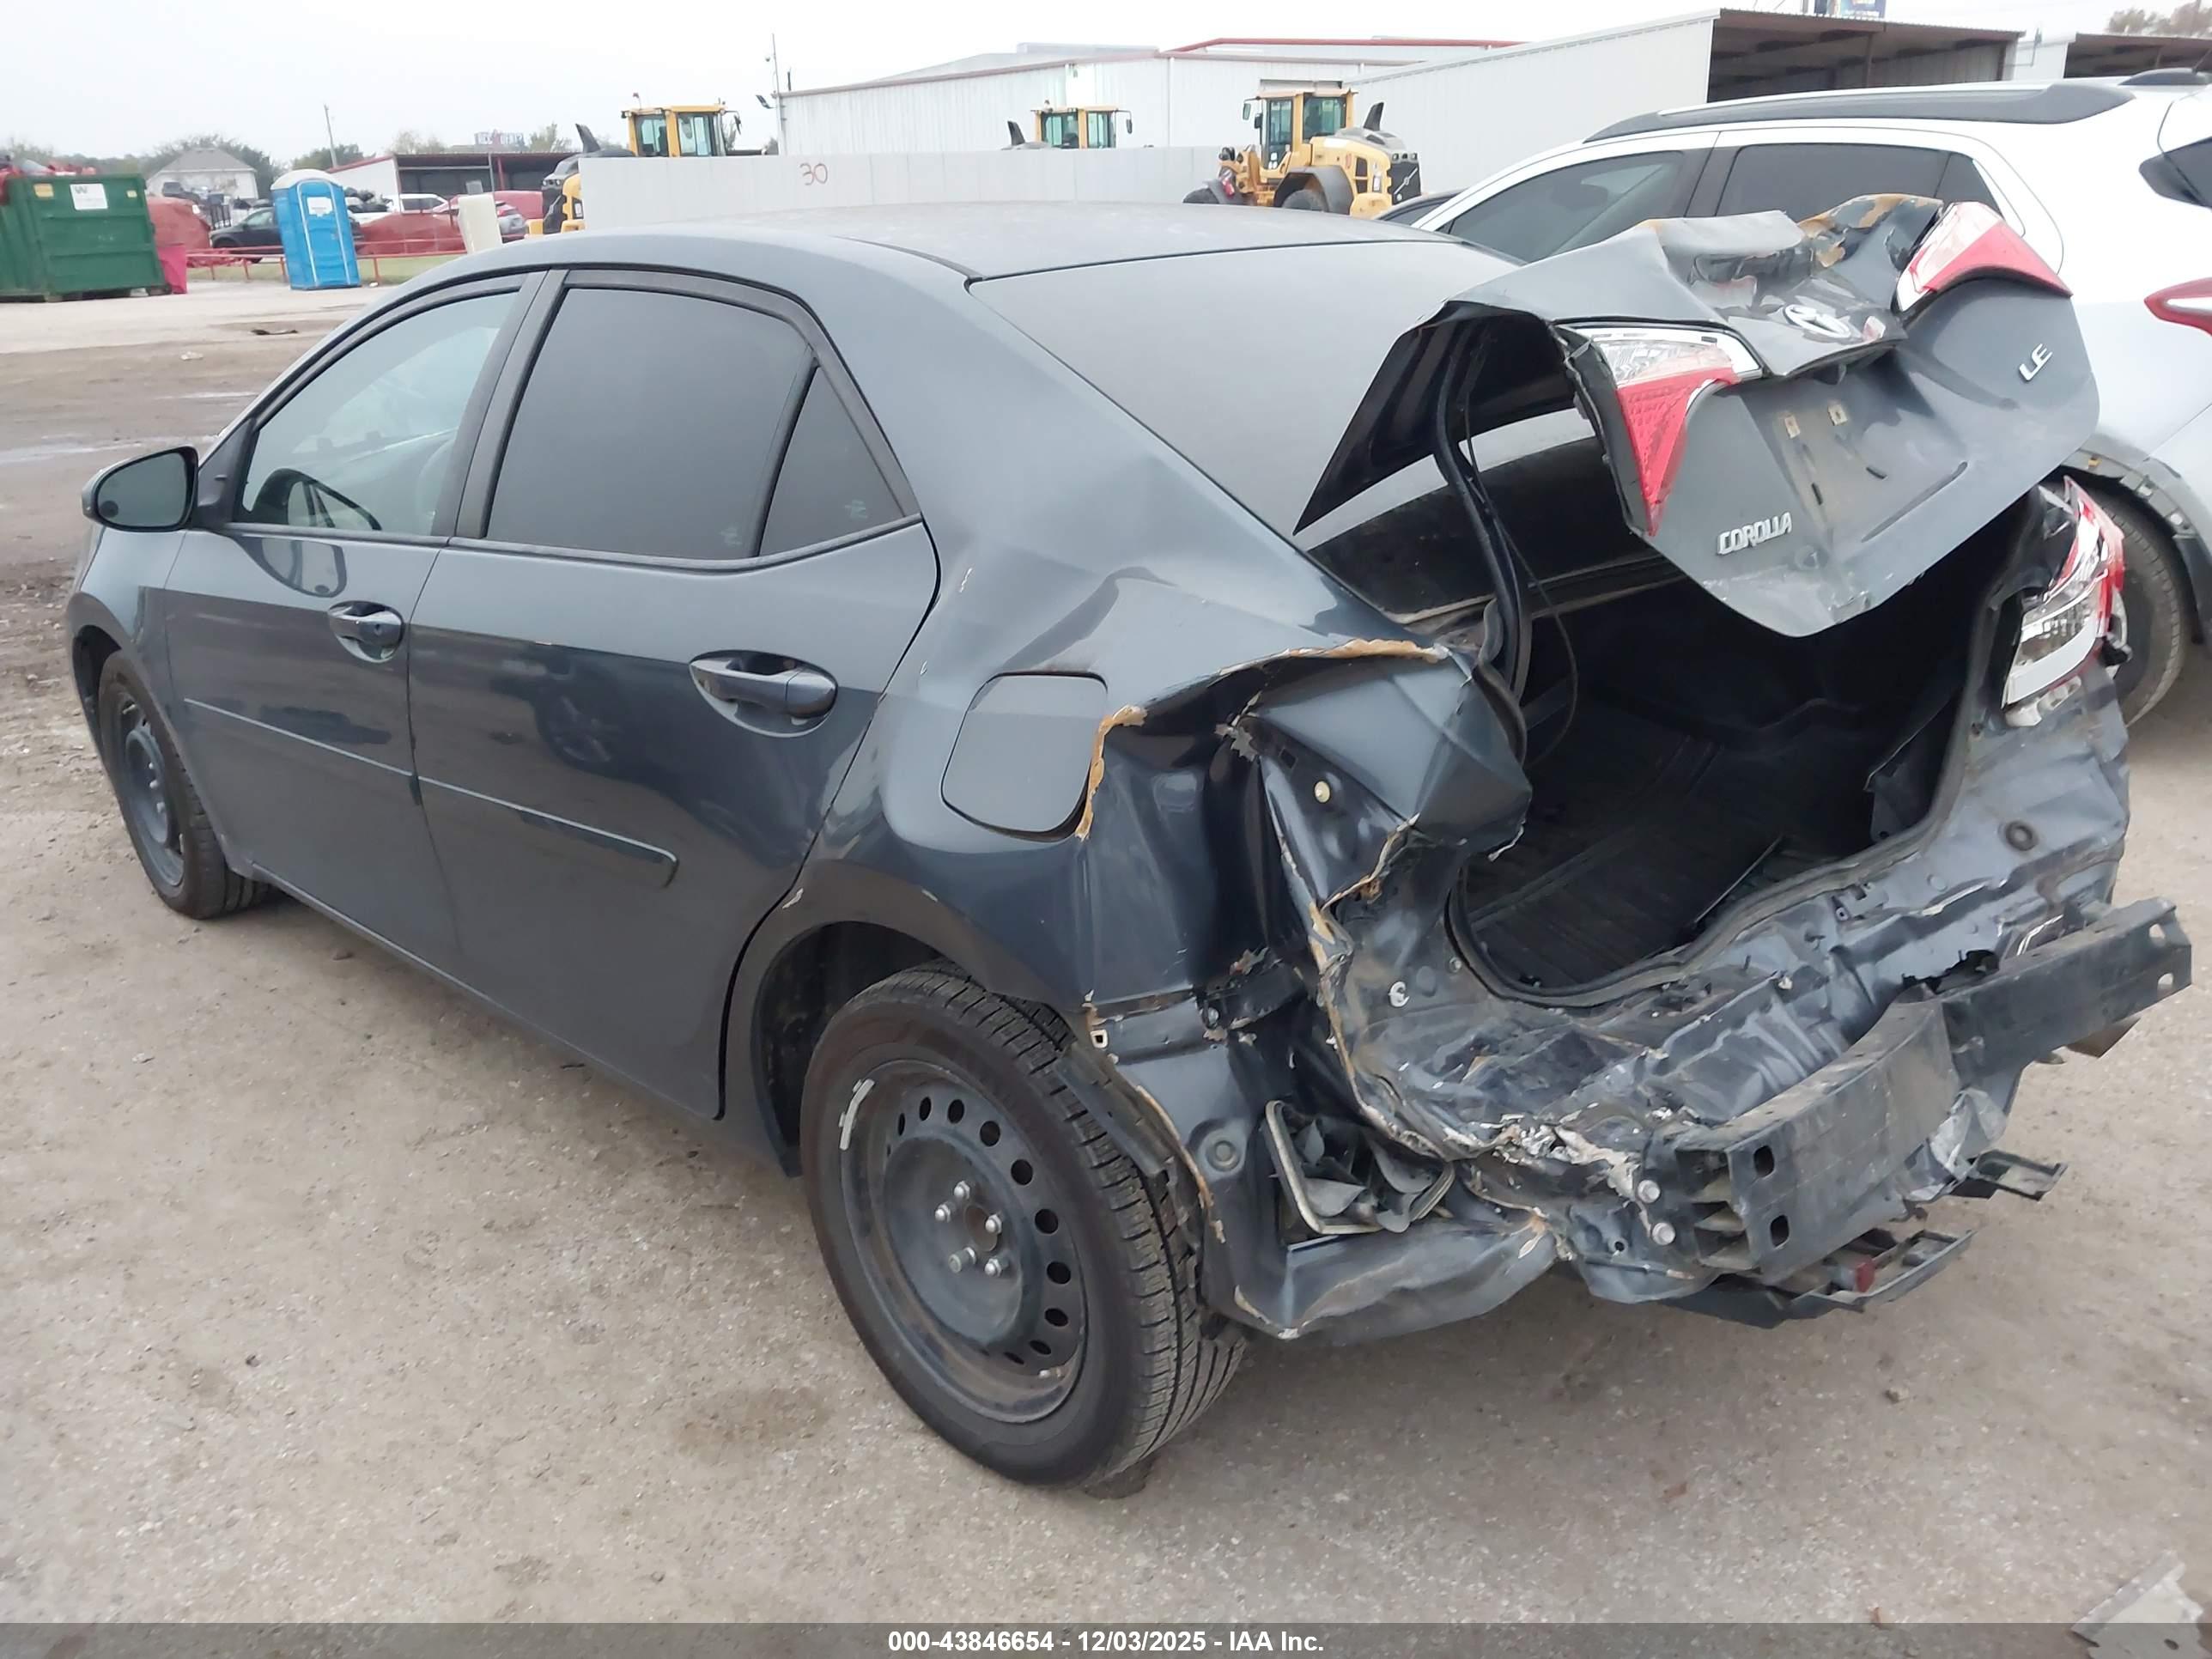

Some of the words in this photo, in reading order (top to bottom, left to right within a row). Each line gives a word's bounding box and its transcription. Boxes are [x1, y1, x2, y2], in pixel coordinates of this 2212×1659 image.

[799, 162, 829, 185] 30
[2018, 343, 2054, 381] LE
[1717, 511, 1793, 556] COROLLA
